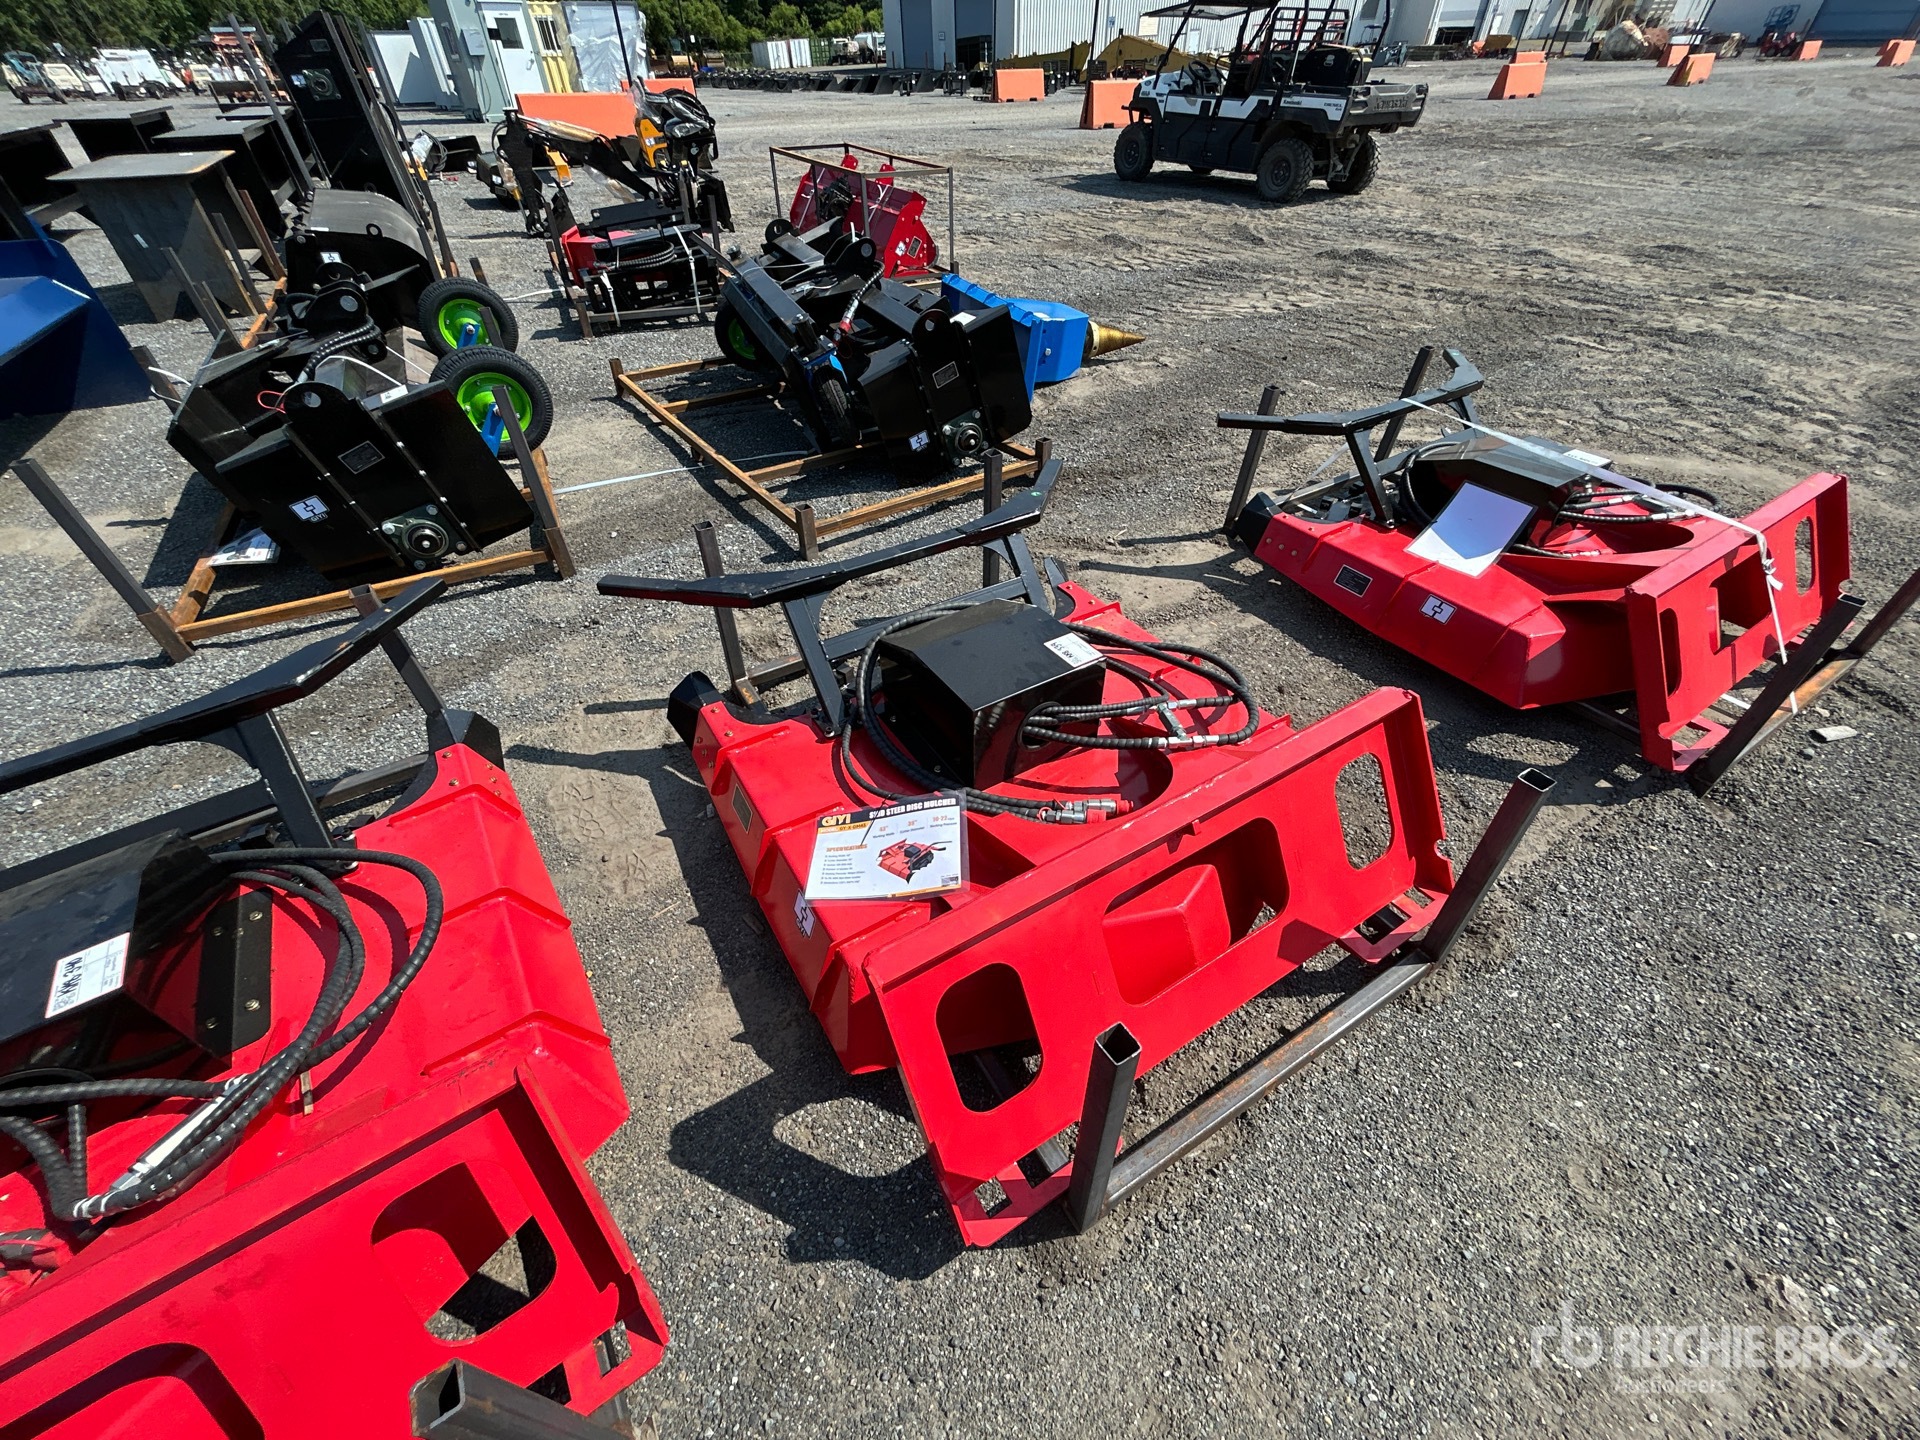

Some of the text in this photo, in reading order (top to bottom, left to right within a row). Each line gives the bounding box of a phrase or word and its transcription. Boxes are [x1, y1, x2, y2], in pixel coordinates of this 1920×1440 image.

[311, 512, 326, 521] GIYI
[822, 813, 851, 826] GIYI
[886, 805, 905, 816] STEER
[906, 802, 923, 811] DISC
[923, 798, 957, 809] MULCHER
